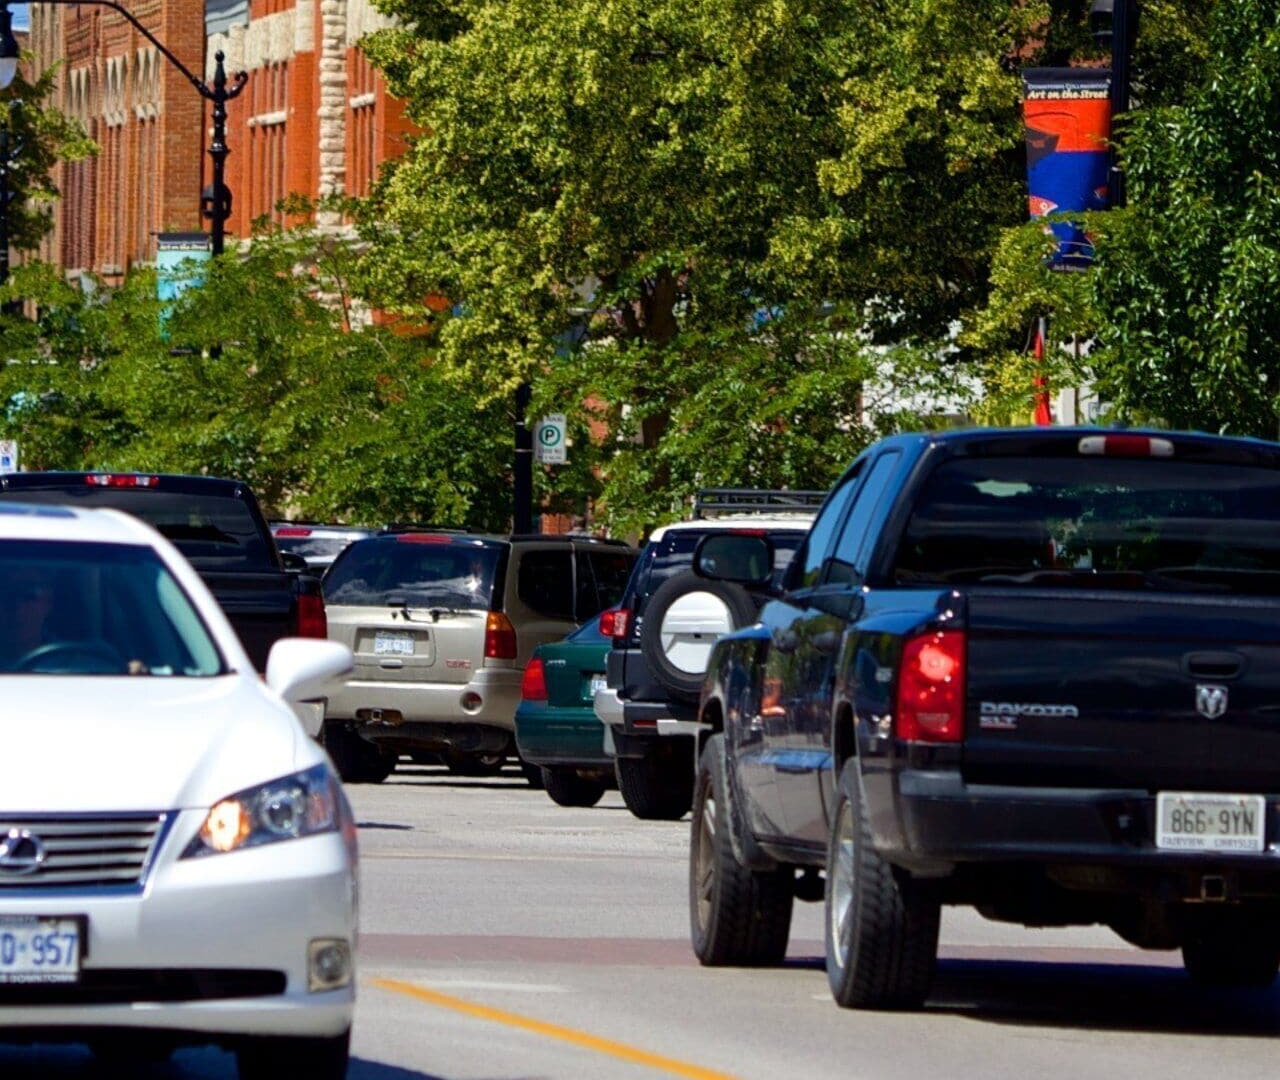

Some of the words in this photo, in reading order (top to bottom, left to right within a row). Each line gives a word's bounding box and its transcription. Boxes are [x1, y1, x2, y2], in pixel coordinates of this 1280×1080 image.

[1028, 90, 1046, 99] Art
[1081, 89, 1109, 99] Street
[980, 702, 1079, 718] DAKOTA
[1171, 809, 1207, 834] 866
[1219, 810, 1255, 835] 9YN
[32, 932, 78, 965] 957
